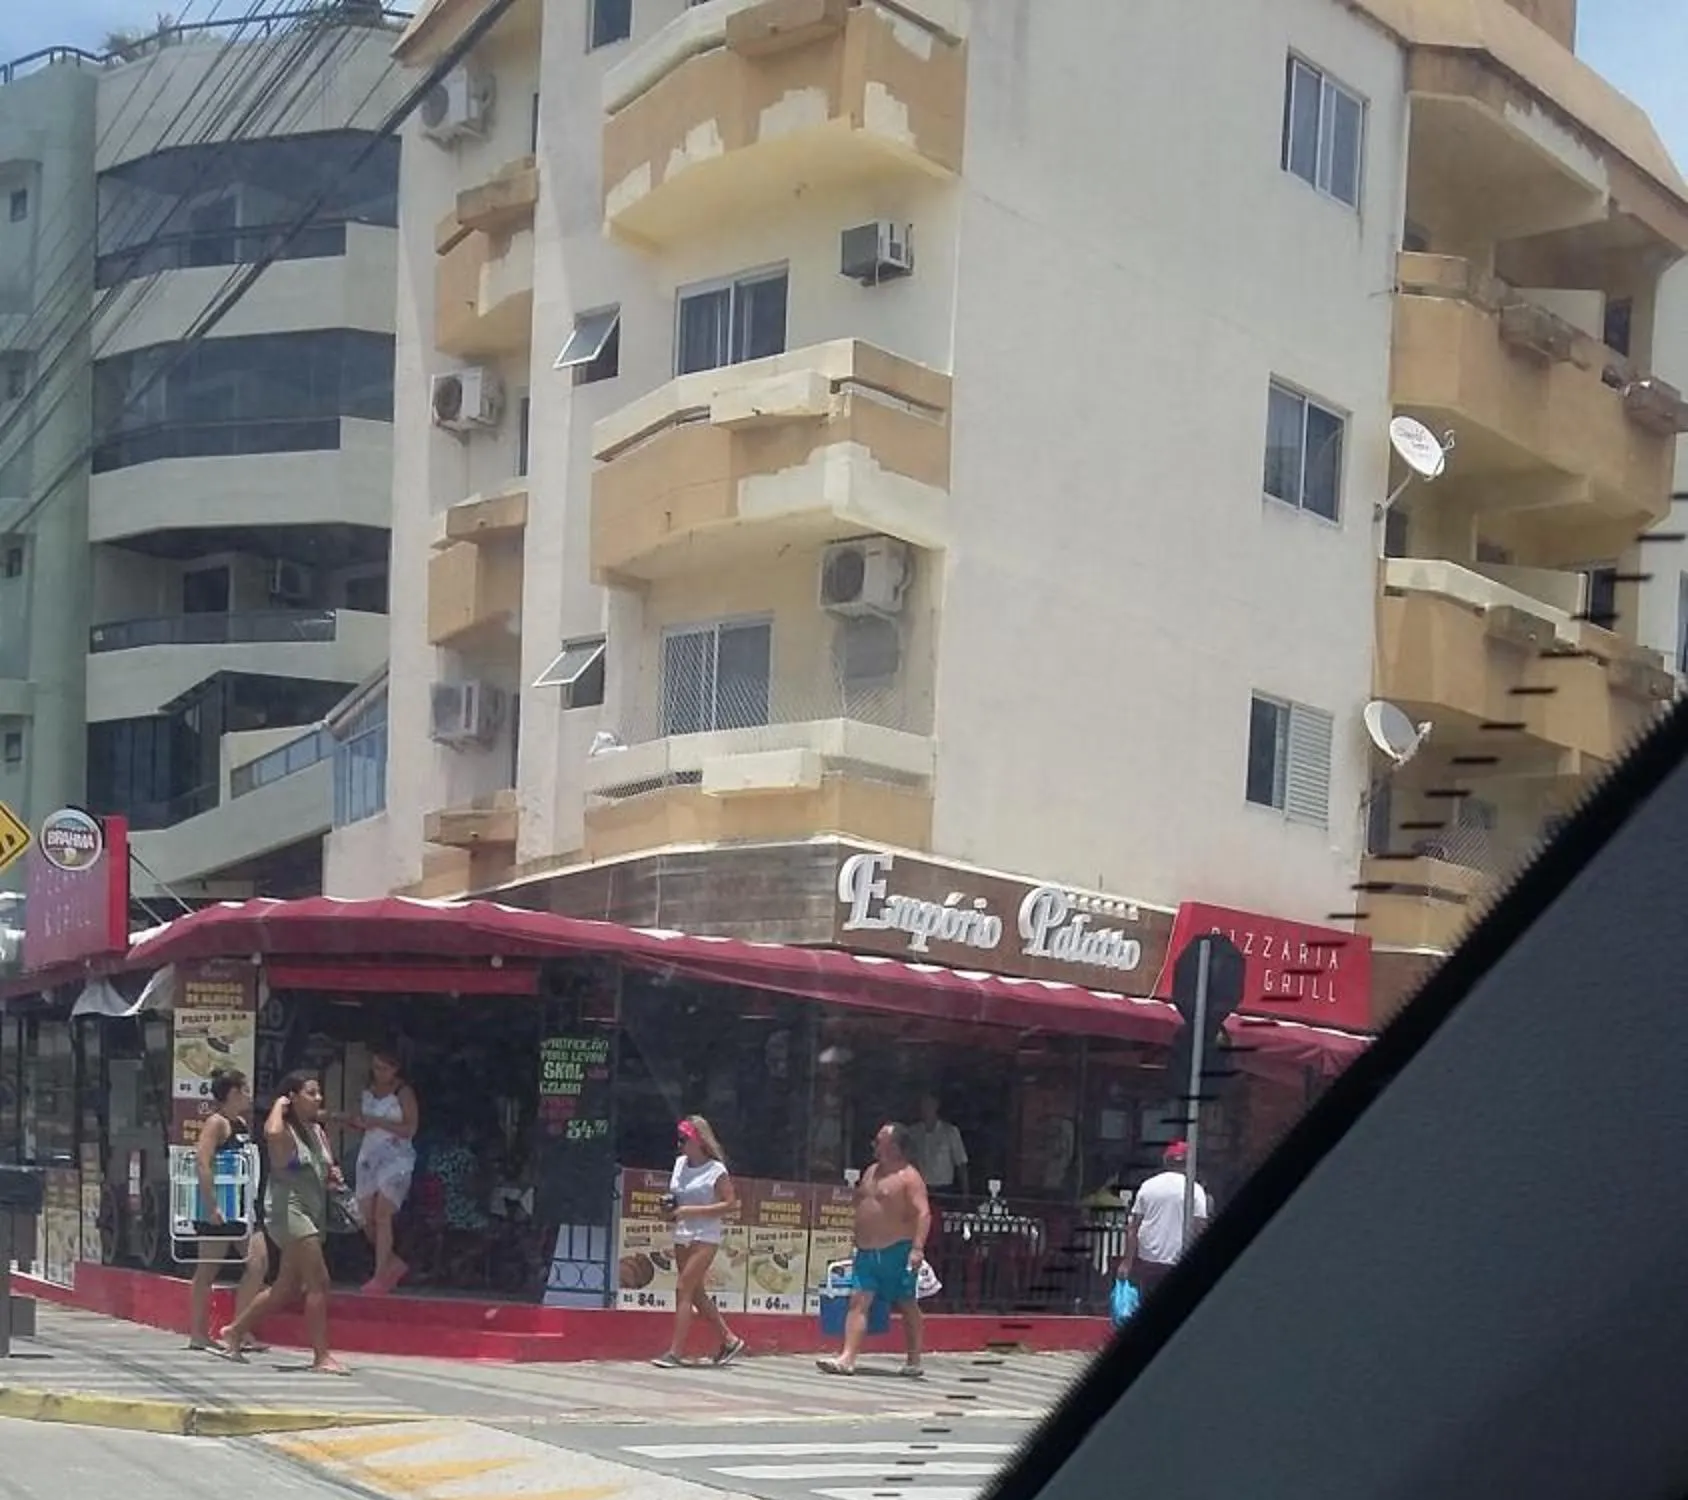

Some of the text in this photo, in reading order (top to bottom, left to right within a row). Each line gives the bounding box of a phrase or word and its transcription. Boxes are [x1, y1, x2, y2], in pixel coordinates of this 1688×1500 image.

[47, 831, 95, 849] BRAHMA
[838, 853, 1002, 953] Empório
[1263, 969, 1337, 1002] GRILL
[543, 1061, 584, 1079] SKOL
